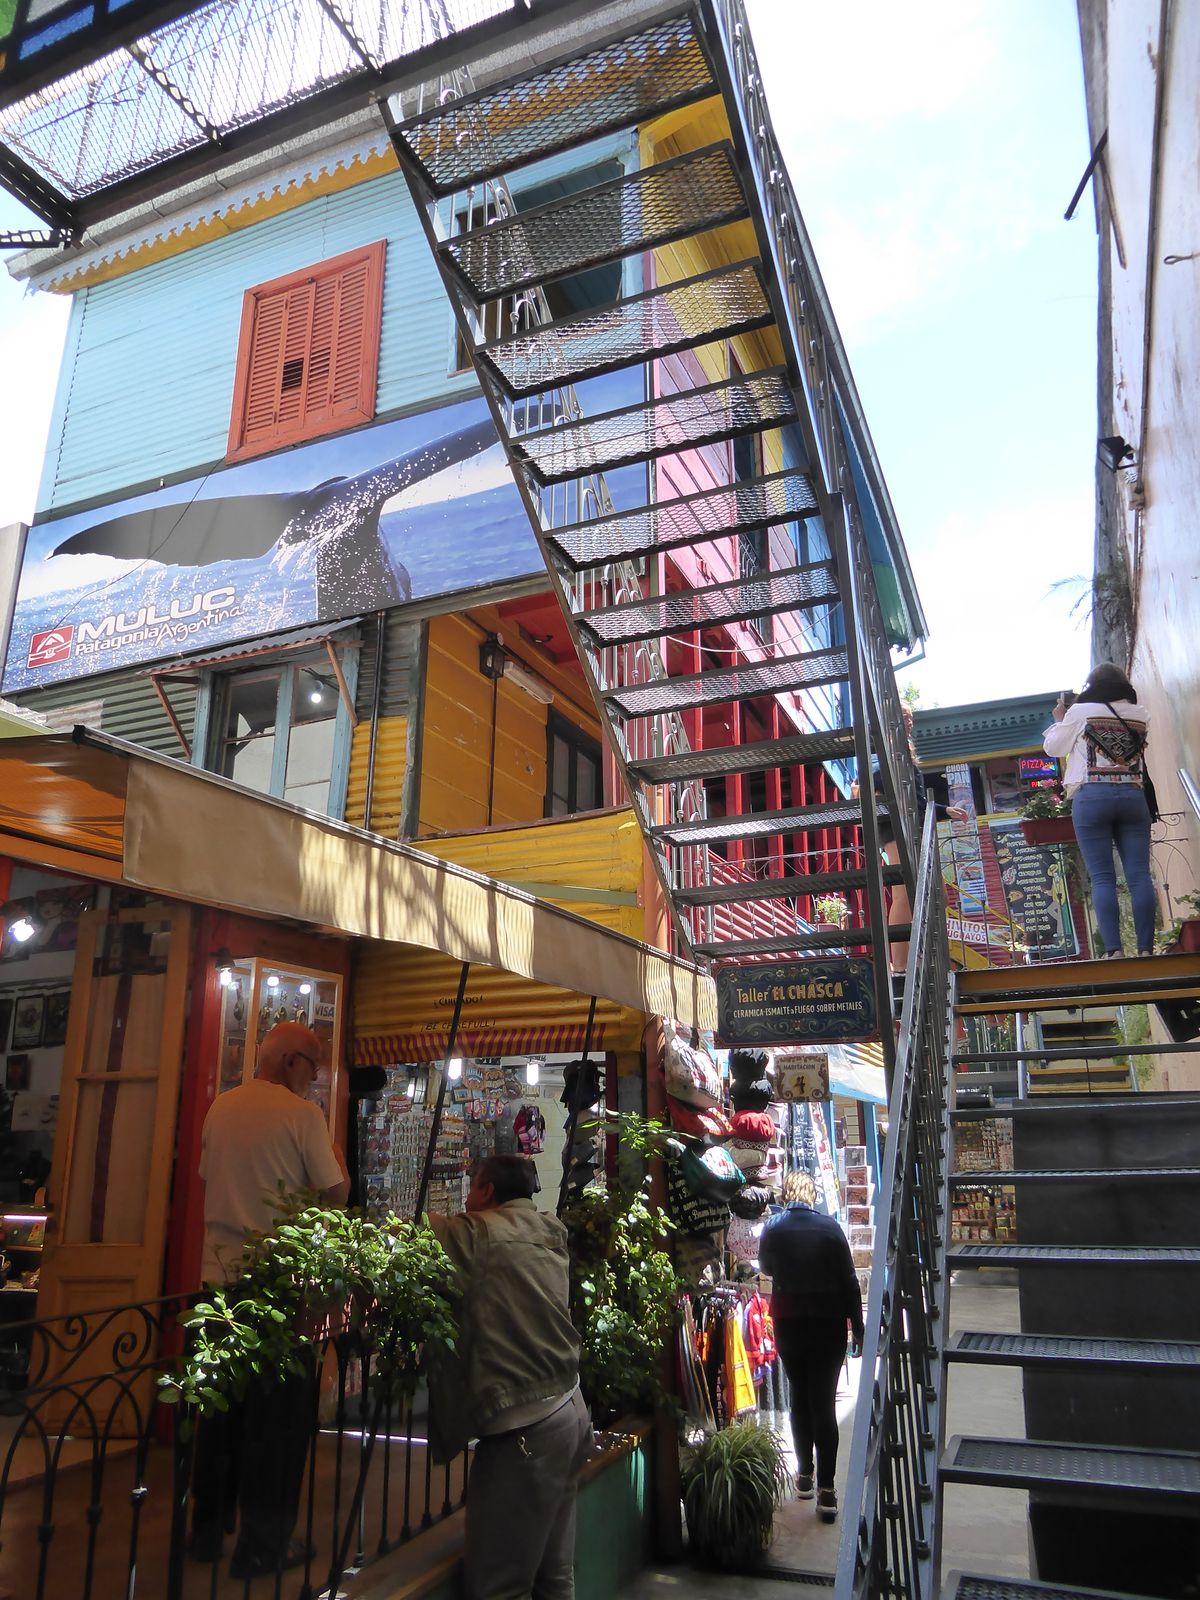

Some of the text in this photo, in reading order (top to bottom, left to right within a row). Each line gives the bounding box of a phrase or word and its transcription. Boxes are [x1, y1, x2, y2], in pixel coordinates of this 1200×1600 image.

[77, 586, 236, 644] MULUC
[155, 605, 246, 646] Argentina
[946, 763, 969, 773] CHORI
[1021, 760, 1045, 769] PIZZA
[946, 771, 971, 786] PAN
[946, 920, 986, 935] HIVITOS
[736, 987, 769, 1004] Taller
[315, 1006, 335, 1018] VISA
[794, 1004, 815, 1014] FUEGO
[816, 1002, 836, 1013] SOBRE
[836, 1001, 863, 1012] METALES
